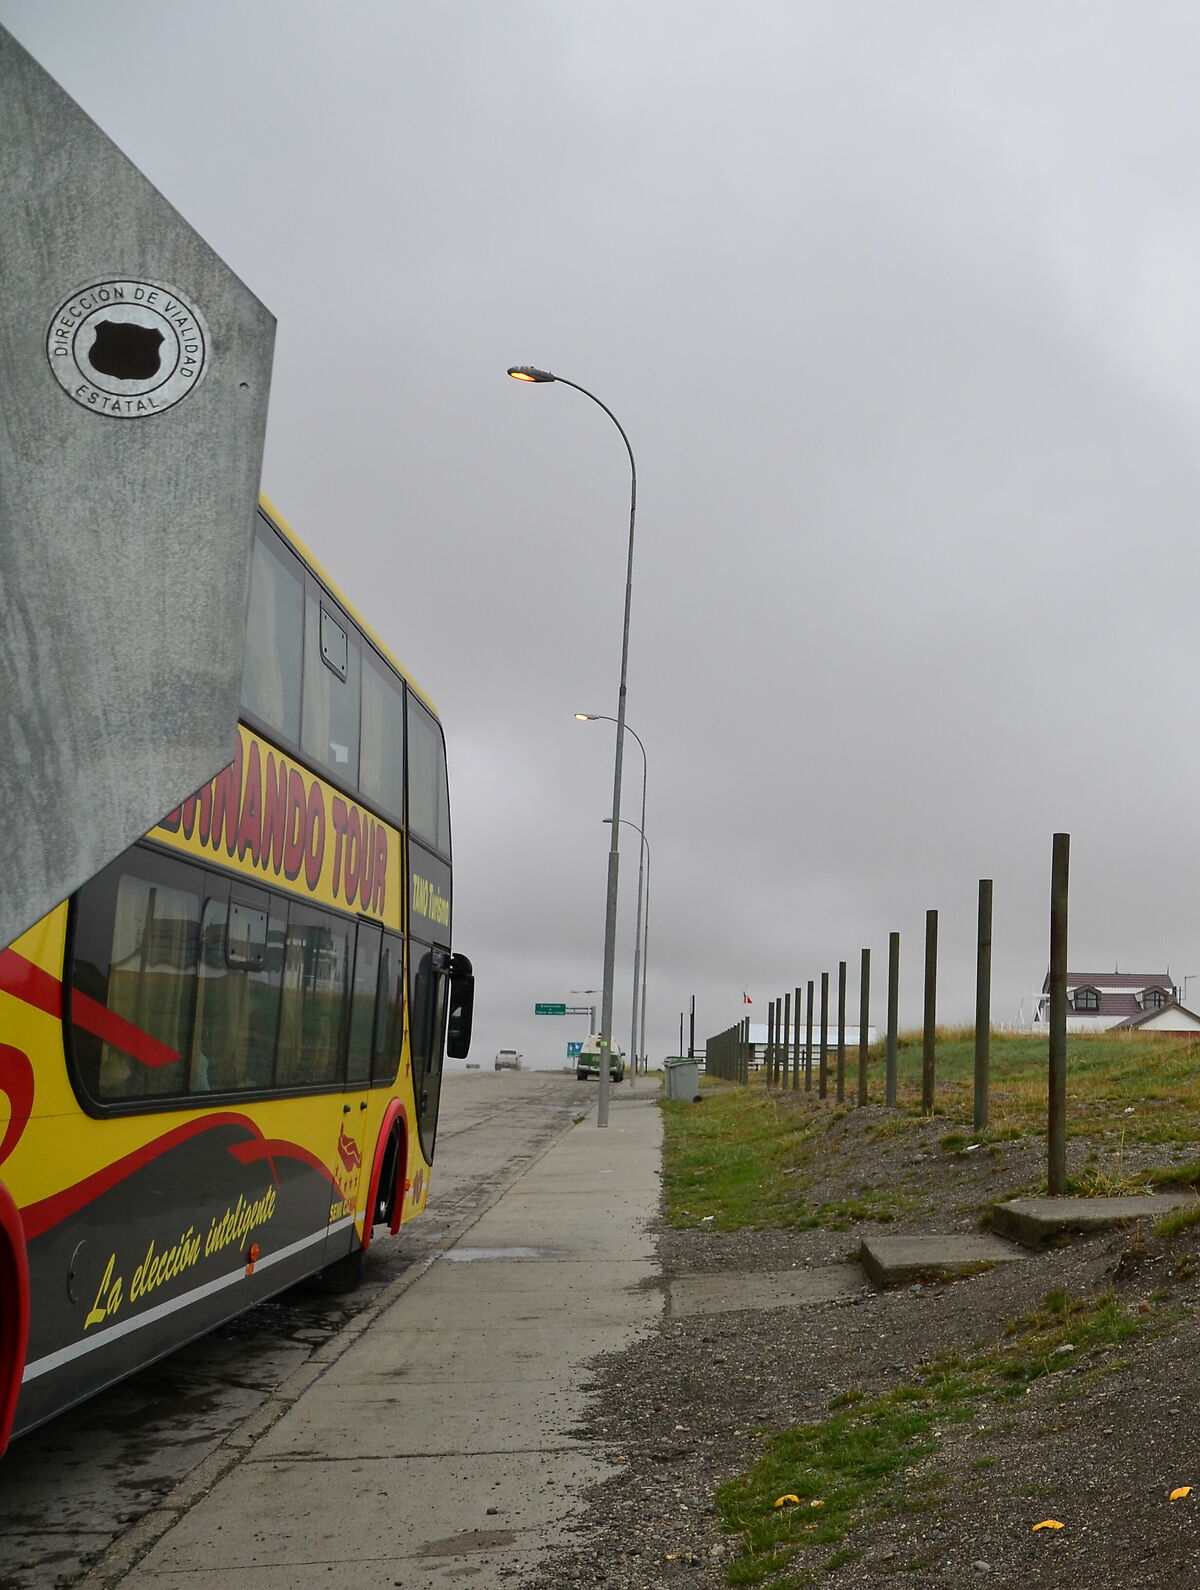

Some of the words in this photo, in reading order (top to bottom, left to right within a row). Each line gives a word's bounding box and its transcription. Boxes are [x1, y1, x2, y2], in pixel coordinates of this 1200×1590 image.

[54, 286, 124, 357] DIRECCIÓN
[134, 287, 159, 304] DE
[164, 301, 198, 378] VIALIDAD
[75, 384, 160, 412] ESTATAL
[331, 795, 388, 917] TOUR
[84, 1252, 123, 1330] La
[130, 1225, 201, 1303] elección
[205, 1184, 276, 1258] inteligente
